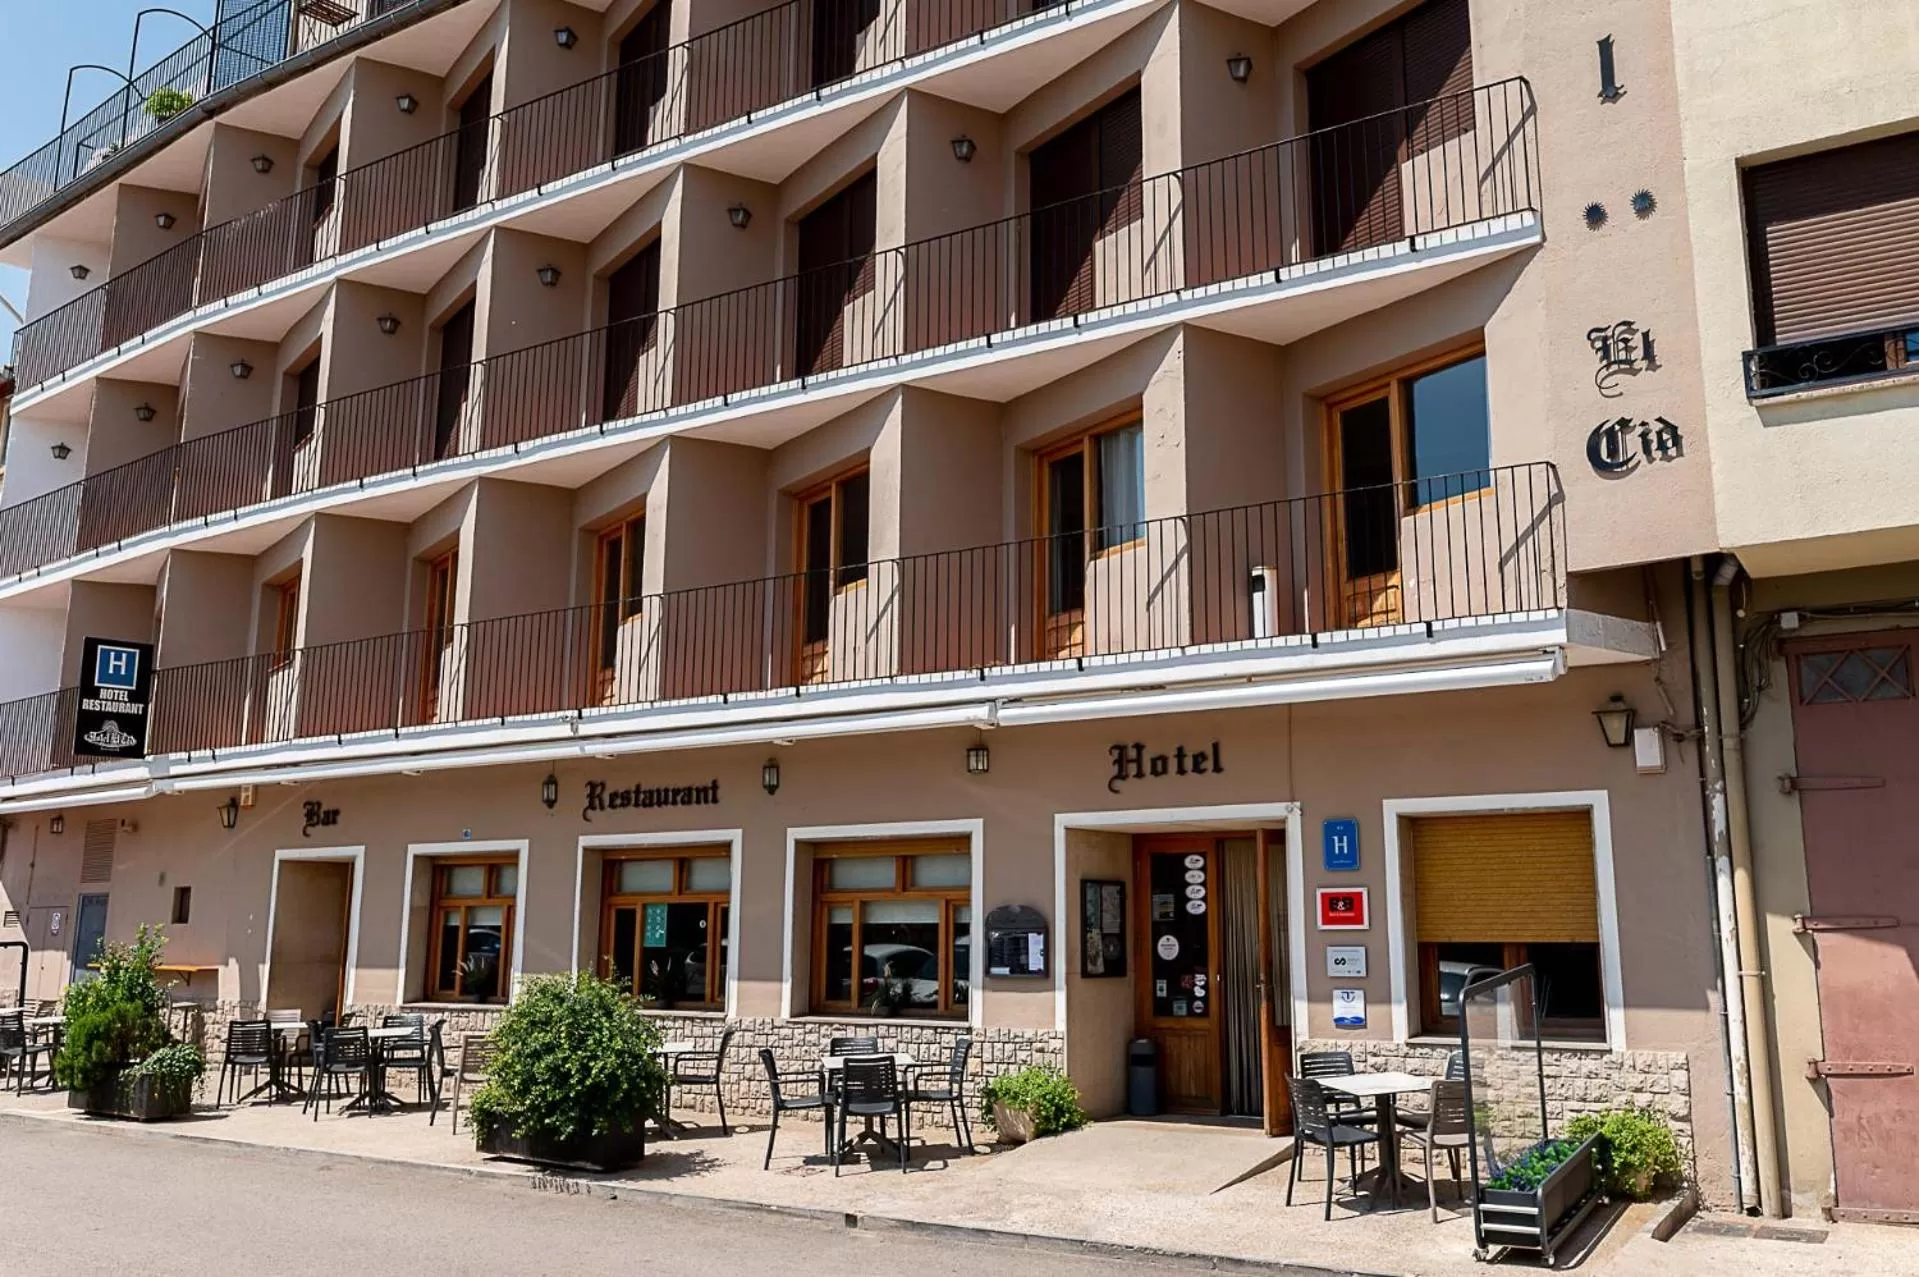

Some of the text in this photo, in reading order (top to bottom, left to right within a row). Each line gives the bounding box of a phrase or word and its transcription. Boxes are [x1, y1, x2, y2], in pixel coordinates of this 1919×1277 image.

[1586, 320, 1663, 399] El
[1585, 416, 1685, 481] Cid
[108, 651, 127, 675] H
[82, 698, 144, 715] RESTAURANT
[100, 688, 128, 701] HOTEL
[1107, 739, 1224, 794] Hotel
[302, 800, 341, 838] Bar
[583, 778, 720, 822] Restaurant
[1332, 835, 1348, 855] H
